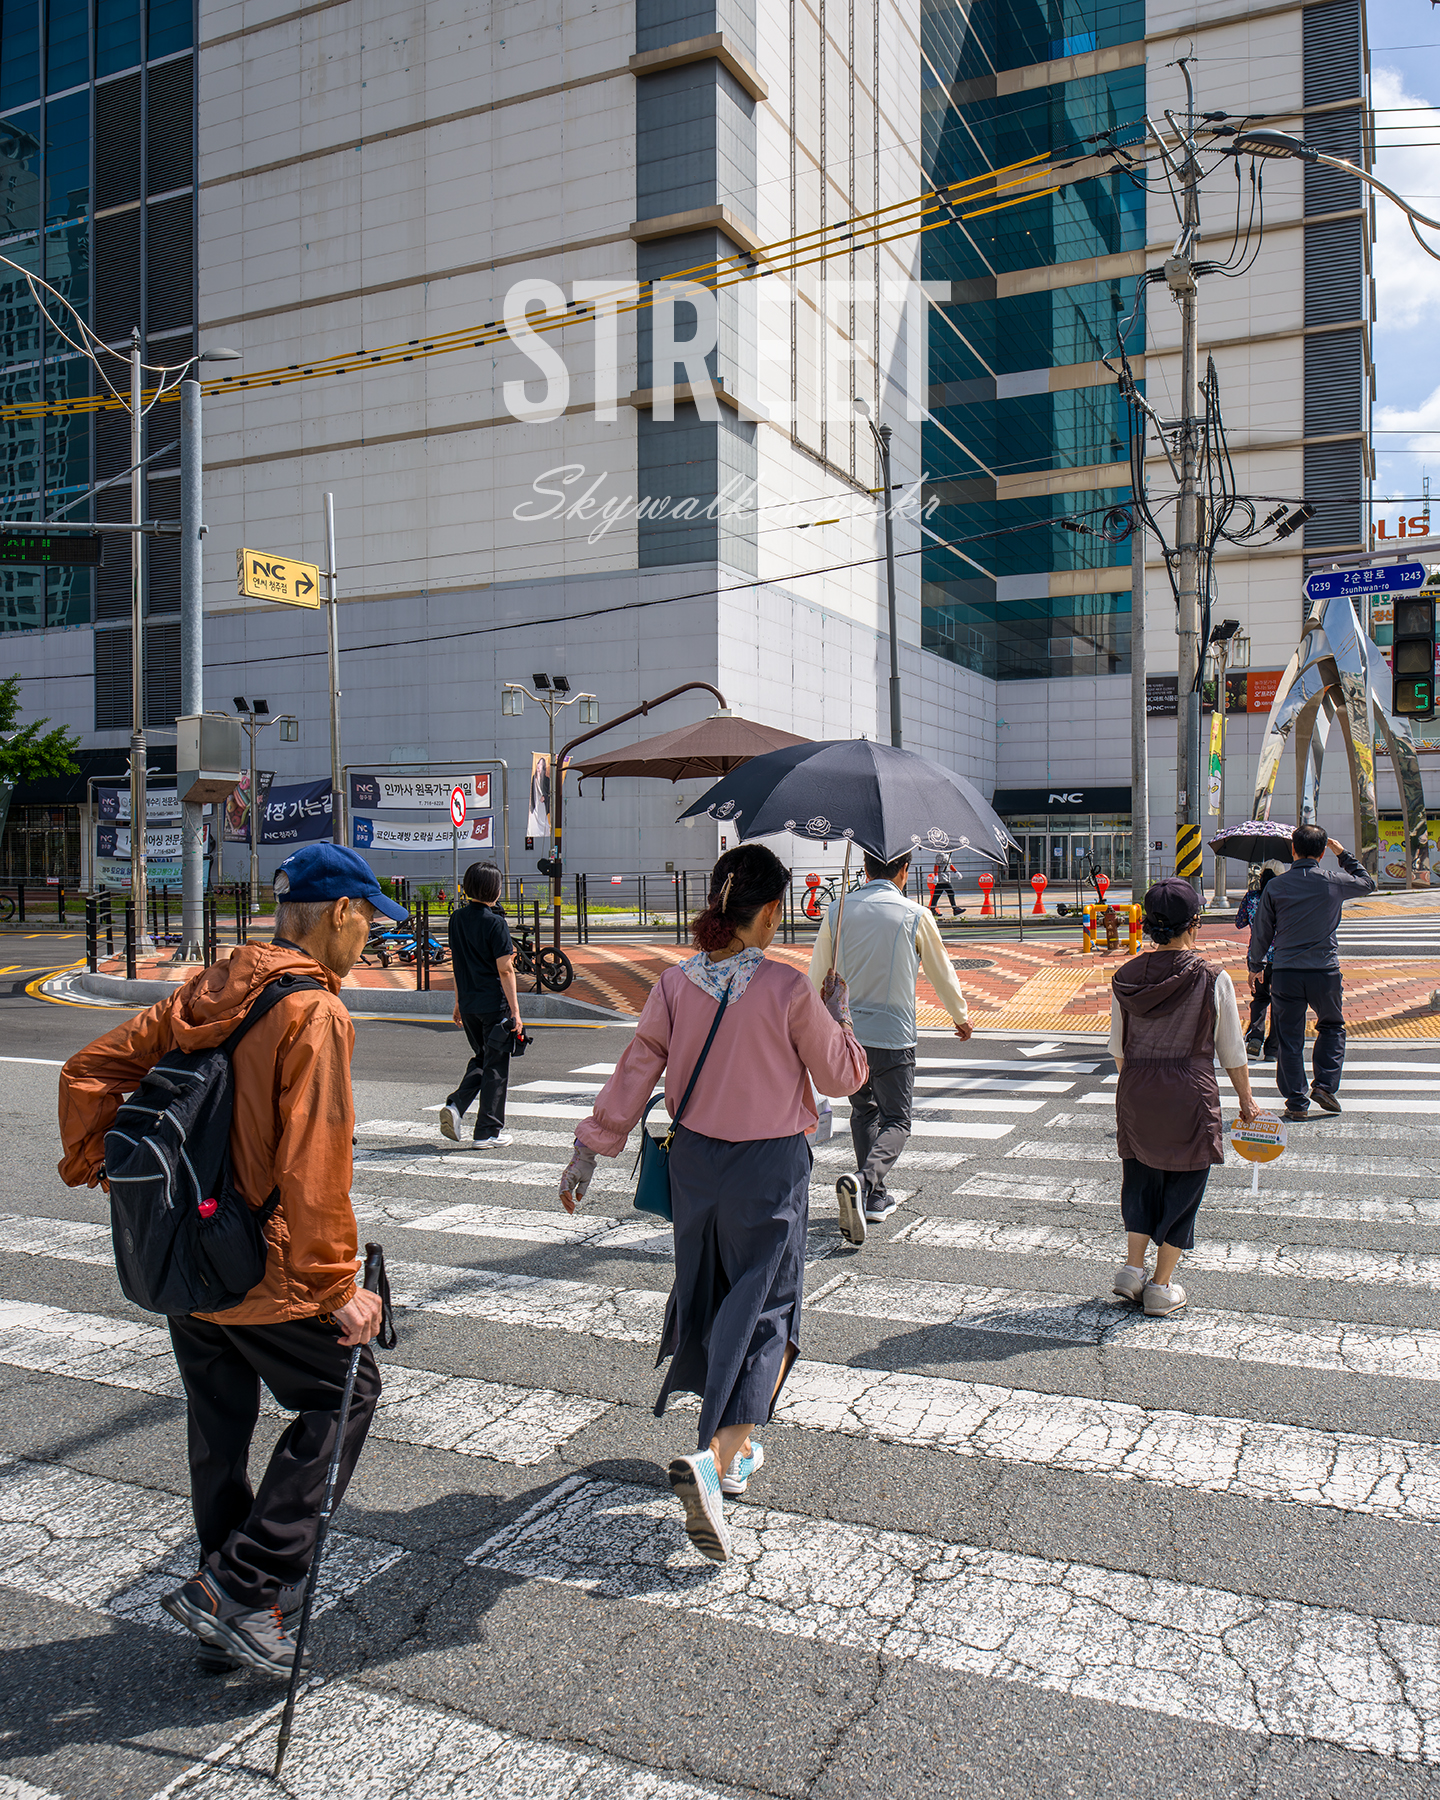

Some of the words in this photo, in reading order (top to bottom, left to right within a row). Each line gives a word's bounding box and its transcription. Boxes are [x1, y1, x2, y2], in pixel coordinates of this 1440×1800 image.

[1372, 516, 1430, 539] LiS
[253, 560, 286, 580] NC
[1344, 569, 1386, 584] 2순환로
[1400, 571, 1421, 581] 1243
[1310, 582, 1331, 592] 1239
[1340, 583, 1390, 595] 2sunhwan-ro
[1415, 683, 1429, 709] 5
[356, 784, 373, 792] NC
[384, 784, 413, 796] 인까사
[415, 783, 452, 796] 원목가구
[477, 781, 487, 789] 4F
[102, 798, 115, 806] NC
[1048, 793, 1083, 804] NC
[357, 824, 368, 832] NC
[101, 834, 113, 843] NC
